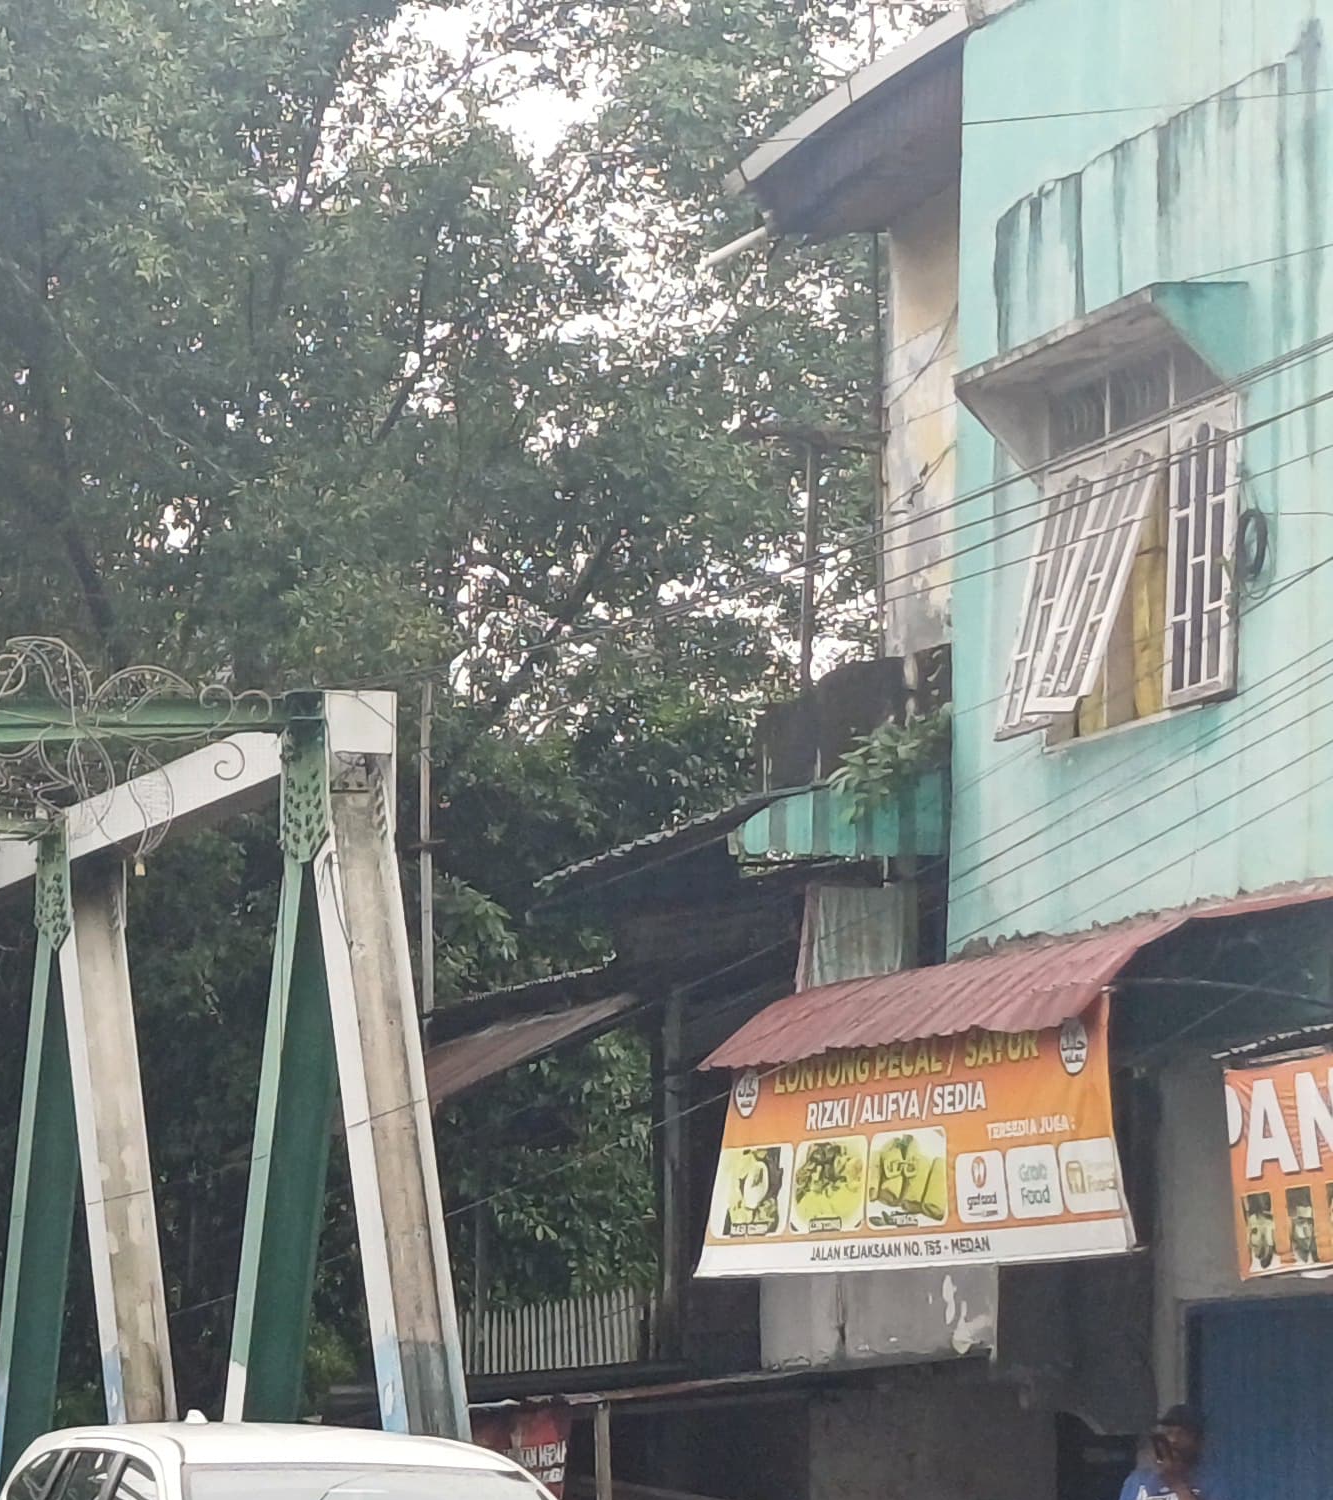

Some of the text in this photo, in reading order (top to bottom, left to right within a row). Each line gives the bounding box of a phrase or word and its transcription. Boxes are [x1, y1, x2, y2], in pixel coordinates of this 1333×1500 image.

[873, 1038, 943, 1081] PECAL
[1020, 1184, 1051, 1208] Food
[810, 1246, 840, 1261] JALAN
[843, 1242, 902, 1260] KEJAKSAAN
[904, 1240, 923, 1257] NO.
[951, 1236, 991, 1254] MEDAN
